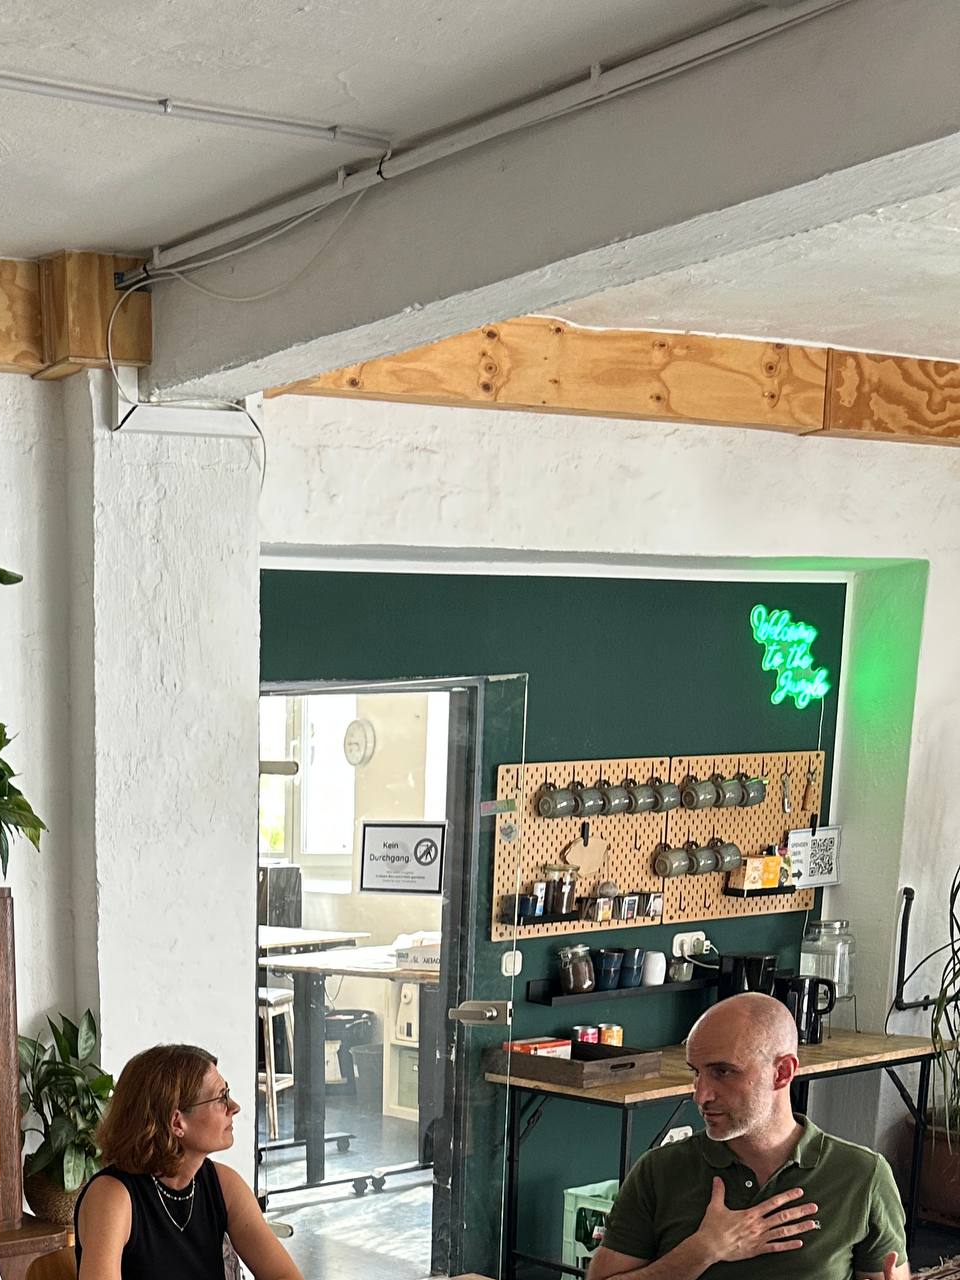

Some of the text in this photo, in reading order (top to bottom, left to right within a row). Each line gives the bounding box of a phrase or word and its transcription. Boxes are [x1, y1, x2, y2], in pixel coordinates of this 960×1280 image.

[753, 606, 817, 644] Welcome
[764, 643, 813, 670] to the
[772, 669, 831, 707] Jungle
[383, 841, 399, 850] Kein
